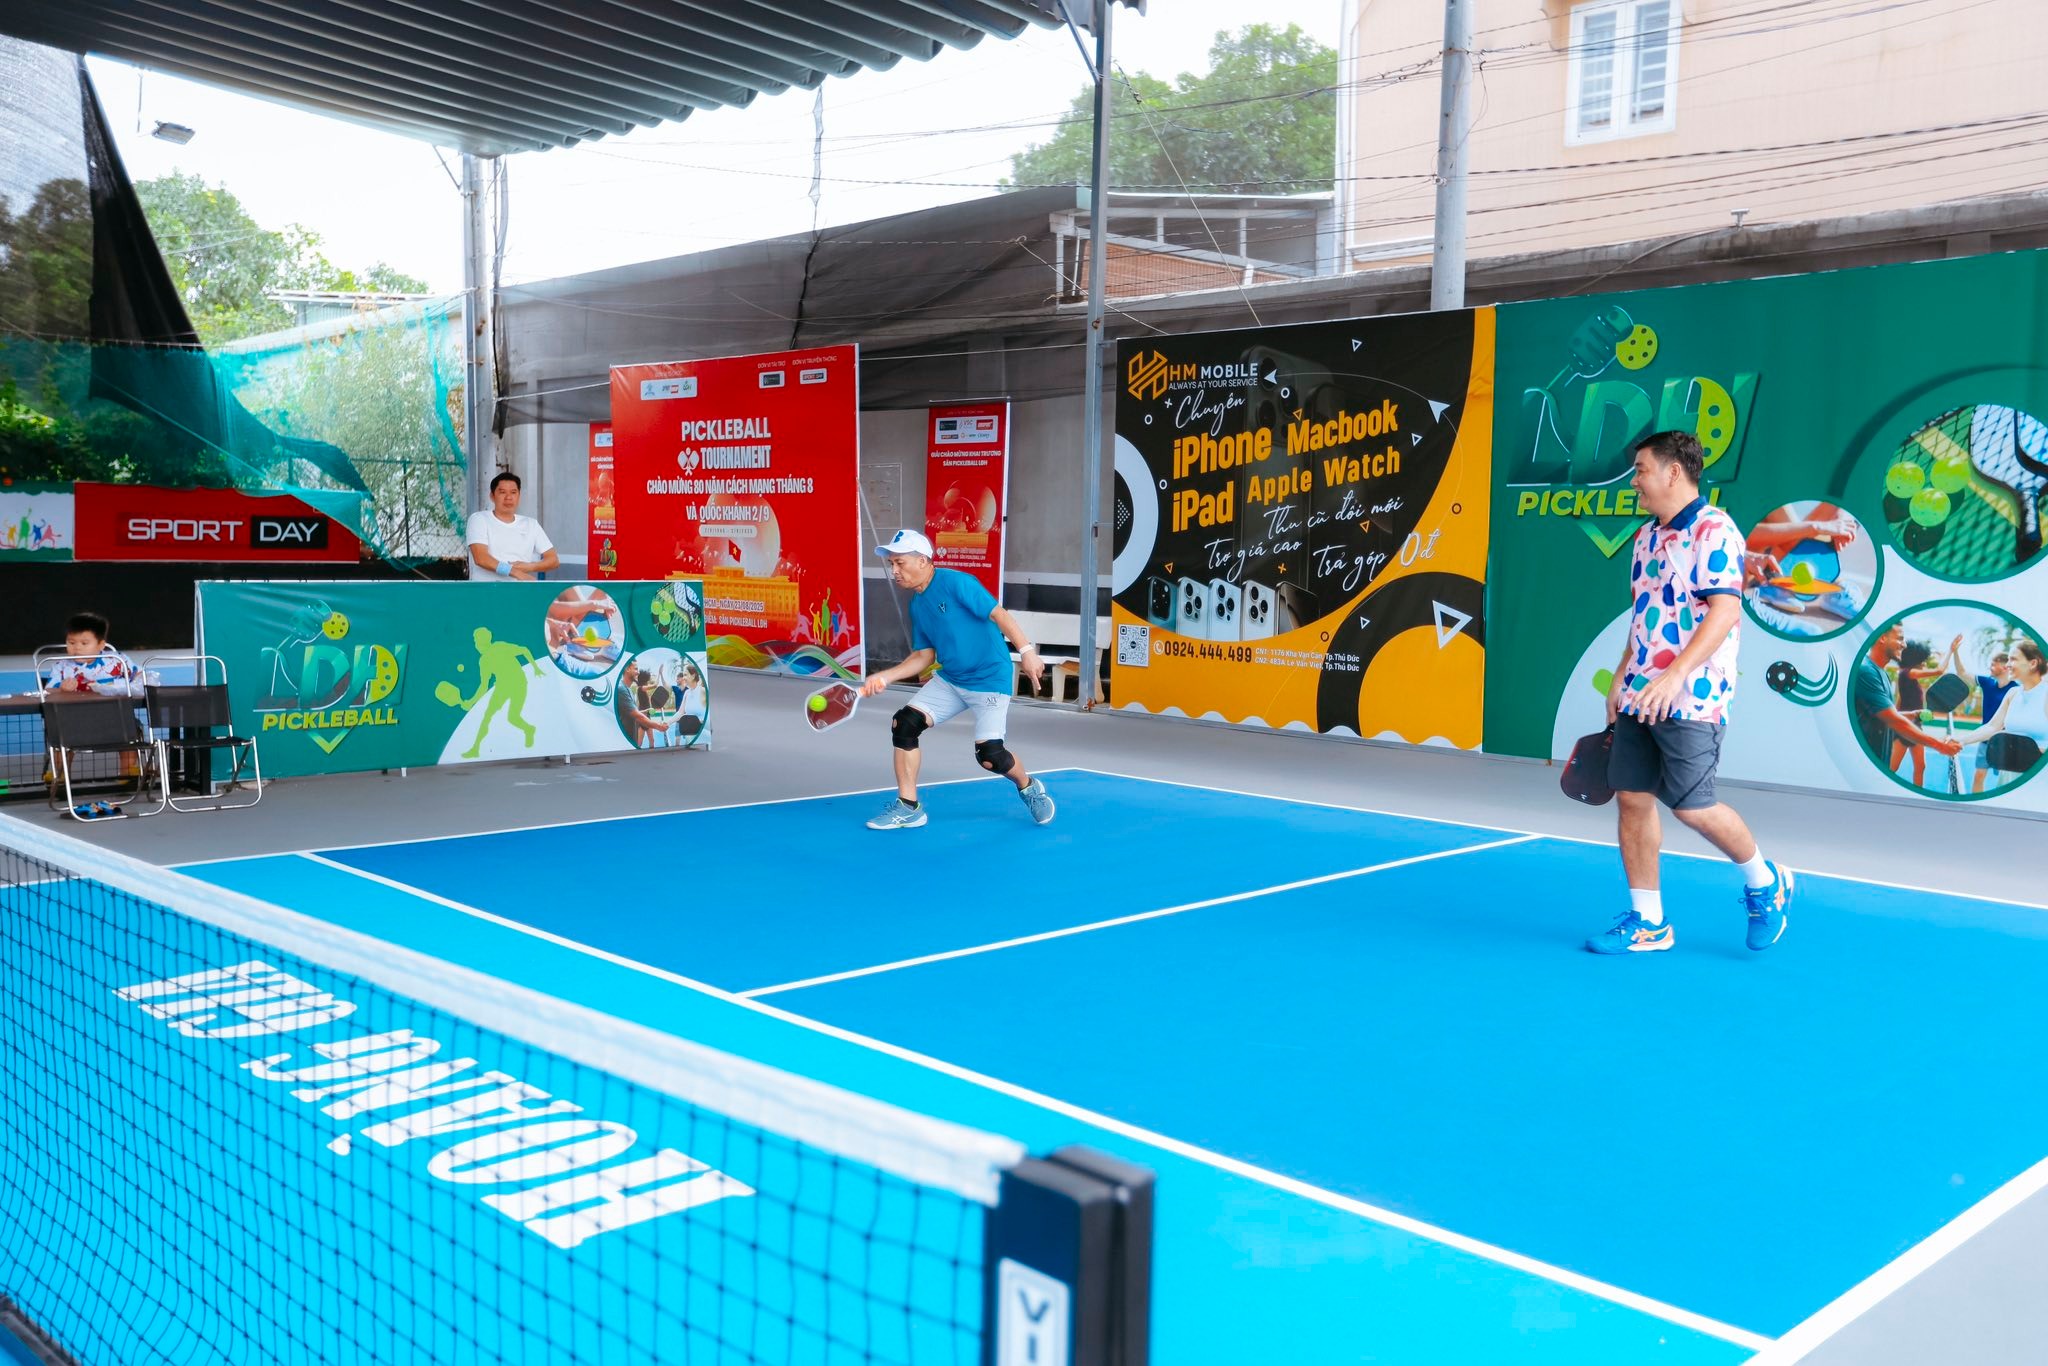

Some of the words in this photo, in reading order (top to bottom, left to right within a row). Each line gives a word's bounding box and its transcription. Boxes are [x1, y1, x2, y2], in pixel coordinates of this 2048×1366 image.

[1168, 381, 1197, 391] ALWAYS
[1197, 380, 1207, 389] AT
[1208, 379, 1228, 388] YOUR
[1228, 377, 1258, 387] SERVICE
[1169, 363, 1197, 381] HM
[1200, 362, 1259, 380] MOBILE
[1175, 389, 1246, 437] Chuyên
[681, 417, 772, 442] PICKLEBALL
[1173, 427, 1272, 480] iPhone
[1286, 398, 1399, 457] Macbook
[700, 445, 772, 470] TOURNAMENT
[646, 476, 668, 495] CHÀO
[668, 475, 693, 495] MỪNG
[694, 480, 704, 494] 80
[705, 475, 725, 494] NĂM
[725, 475, 748, 494] CÁCH
[749, 478, 776, 498] MẠNG
[776, 474, 806, 494] THÁNG
[807, 477, 814, 494] 8
[1172, 480, 1235, 533] iPad
[1246, 466, 1313, 506] Apple
[1323, 445, 1400, 488] Watch
[685, 501, 698, 521] VÀ
[700, 498, 722, 523] QUỐC
[722, 502, 750, 521] KHÁNH
[1517, 488, 1727, 517] PICKLEL
[127, 518, 243, 542] SPORT
[259, 521, 319, 542] DAY
[1263, 504, 1302, 540] Thu
[1307, 511, 1331, 528] cũ
[1226, 540, 1267, 583] giá
[1273, 539, 1303, 555] cao
[1312, 544, 1348, 578] Trả
[1342, 551, 1389, 593] góp
[1164, 640, 1252, 663] 0924.444.499
[262, 707, 399, 732] PICKLEBALL
[112, 959, 358, 1039] GIA
[240, 1029, 756, 1250] HOÀNG
